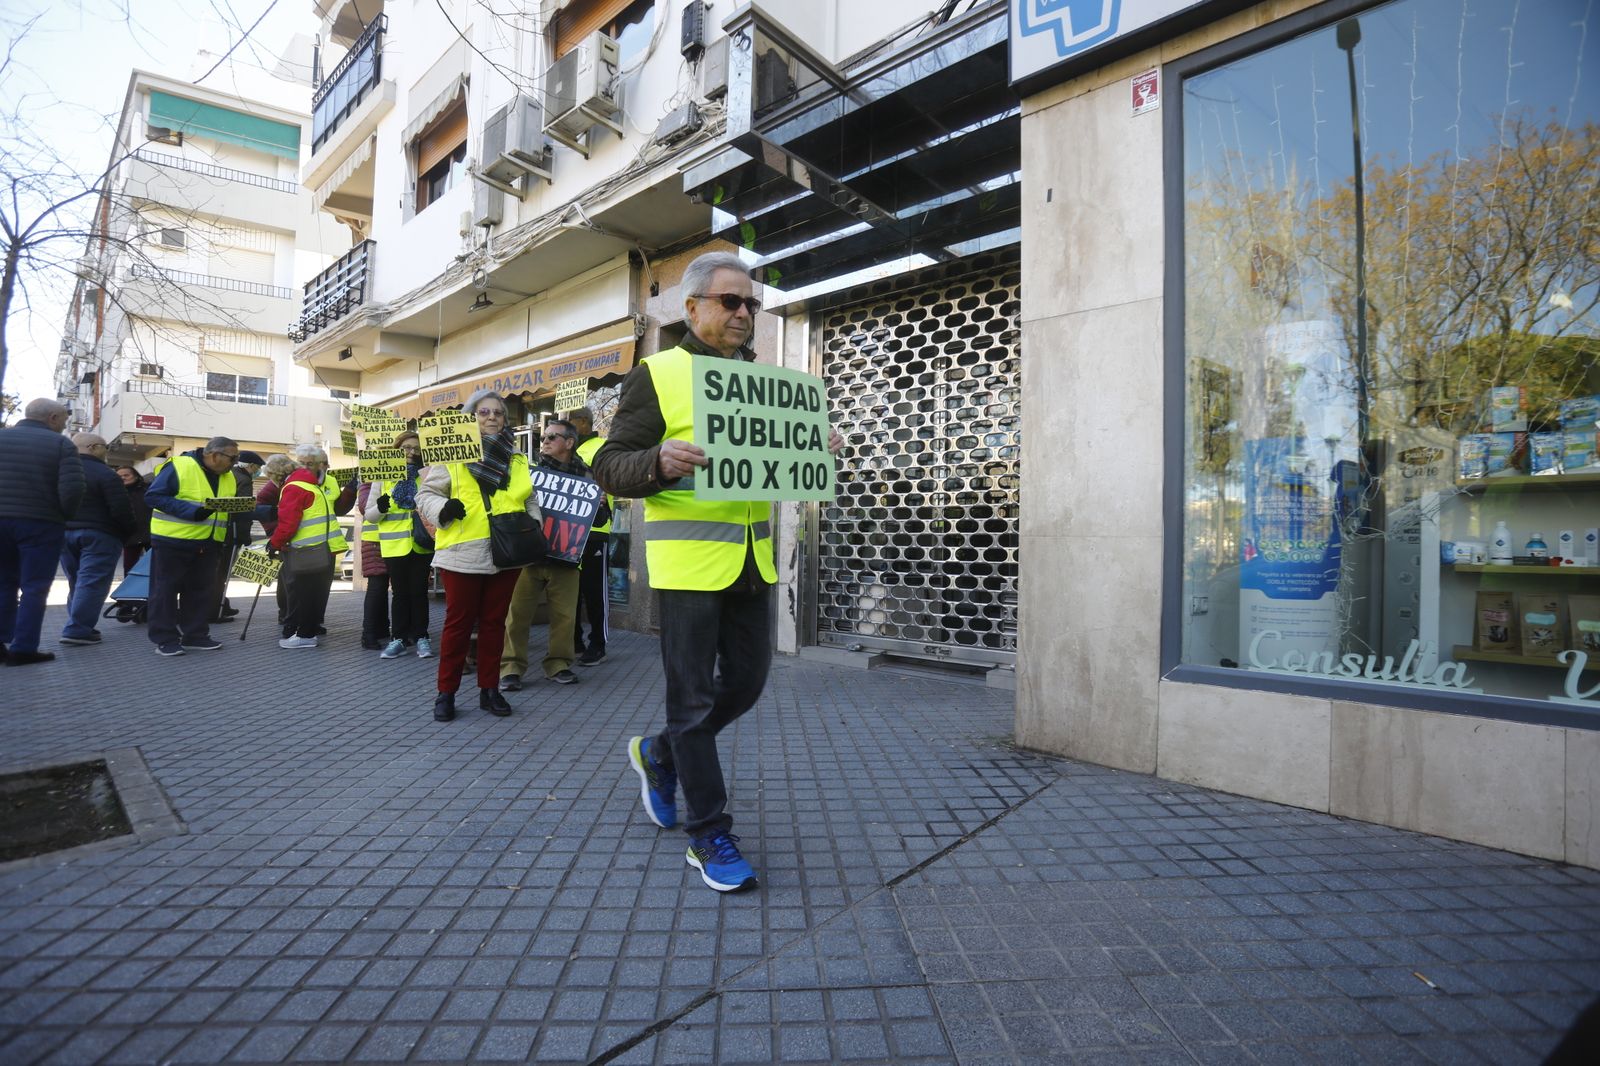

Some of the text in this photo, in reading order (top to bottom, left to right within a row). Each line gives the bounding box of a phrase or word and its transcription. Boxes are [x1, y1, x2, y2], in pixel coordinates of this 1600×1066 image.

[550, 351, 621, 378] COMPRE Y COMPARE
[557, 379, 587, 391] SANIDAD
[704, 370, 820, 412] SANIDAD
[359, 406, 387, 416] FUERA
[418, 415, 476, 428] LAS LISTAS
[440, 426, 454, 434] DE
[707, 408, 824, 452] PÚBLICA
[426, 434, 473, 446] ESPERA
[359, 449, 405, 460] RESCATEMOS
[422, 444, 481, 463] DESESPERAN
[701, 456, 828, 490] 100 X 100
[530, 469, 600, 500] ORTES
[536, 490, 592, 518] NIDAD
[241, 550, 274, 567] CAMAS
[232, 565, 254, 580] CIERRE
[237, 558, 278, 578] DE SERVICIOS
[255, 574, 264, 583] AL
[1249, 630, 1475, 690] Consulta
